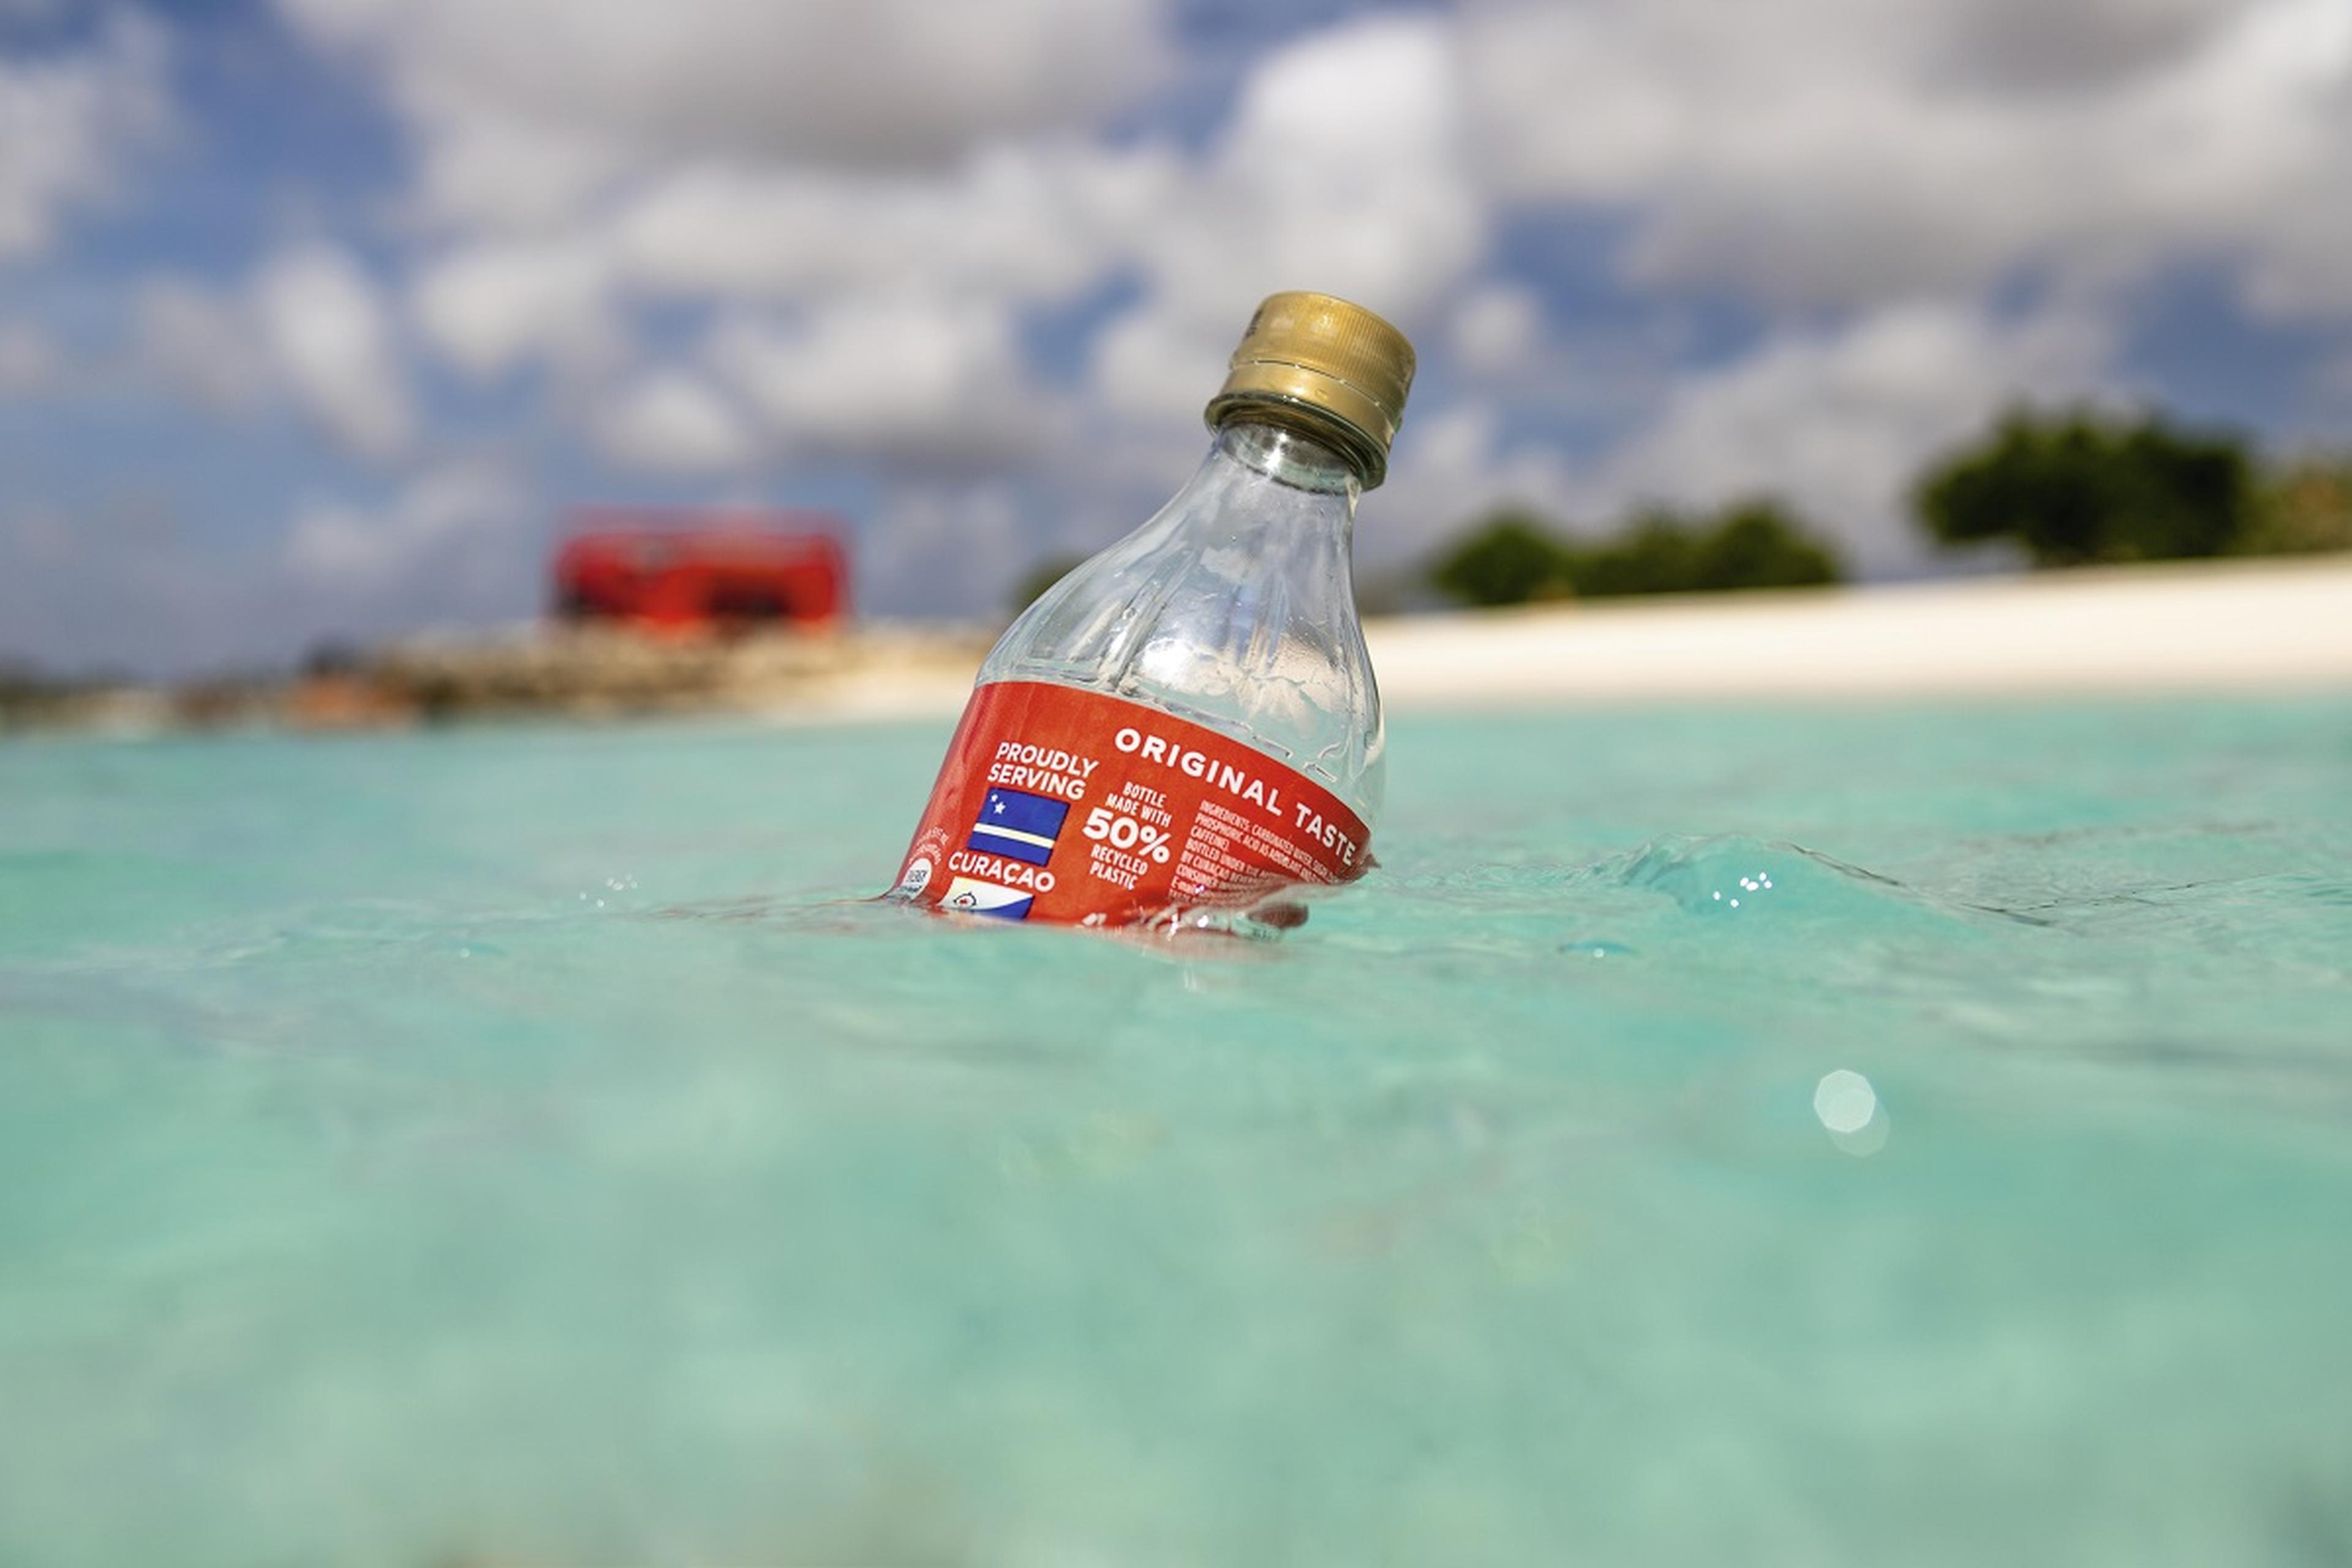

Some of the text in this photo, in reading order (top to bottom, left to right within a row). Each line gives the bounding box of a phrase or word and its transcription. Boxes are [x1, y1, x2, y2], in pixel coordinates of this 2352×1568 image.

[995, 742, 1099, 778] PROUDLY
[987, 763, 1086, 800] SERVING
[1115, 728, 1356, 867] ORIGINAL TASTE
[1123, 781, 1167, 808] BOTTLE
[1105, 793, 1172, 827] MADE WITH
[1082, 807, 1171, 863] 50%
[1185, 837, 1221, 862] BOTTLED
[948, 851, 1055, 892] CURAÇAO
[1091, 843, 1148, 876] RECYCLED
[1180, 850, 1194, 866] BY
[1089, 861, 1138, 890] PLASTIC
